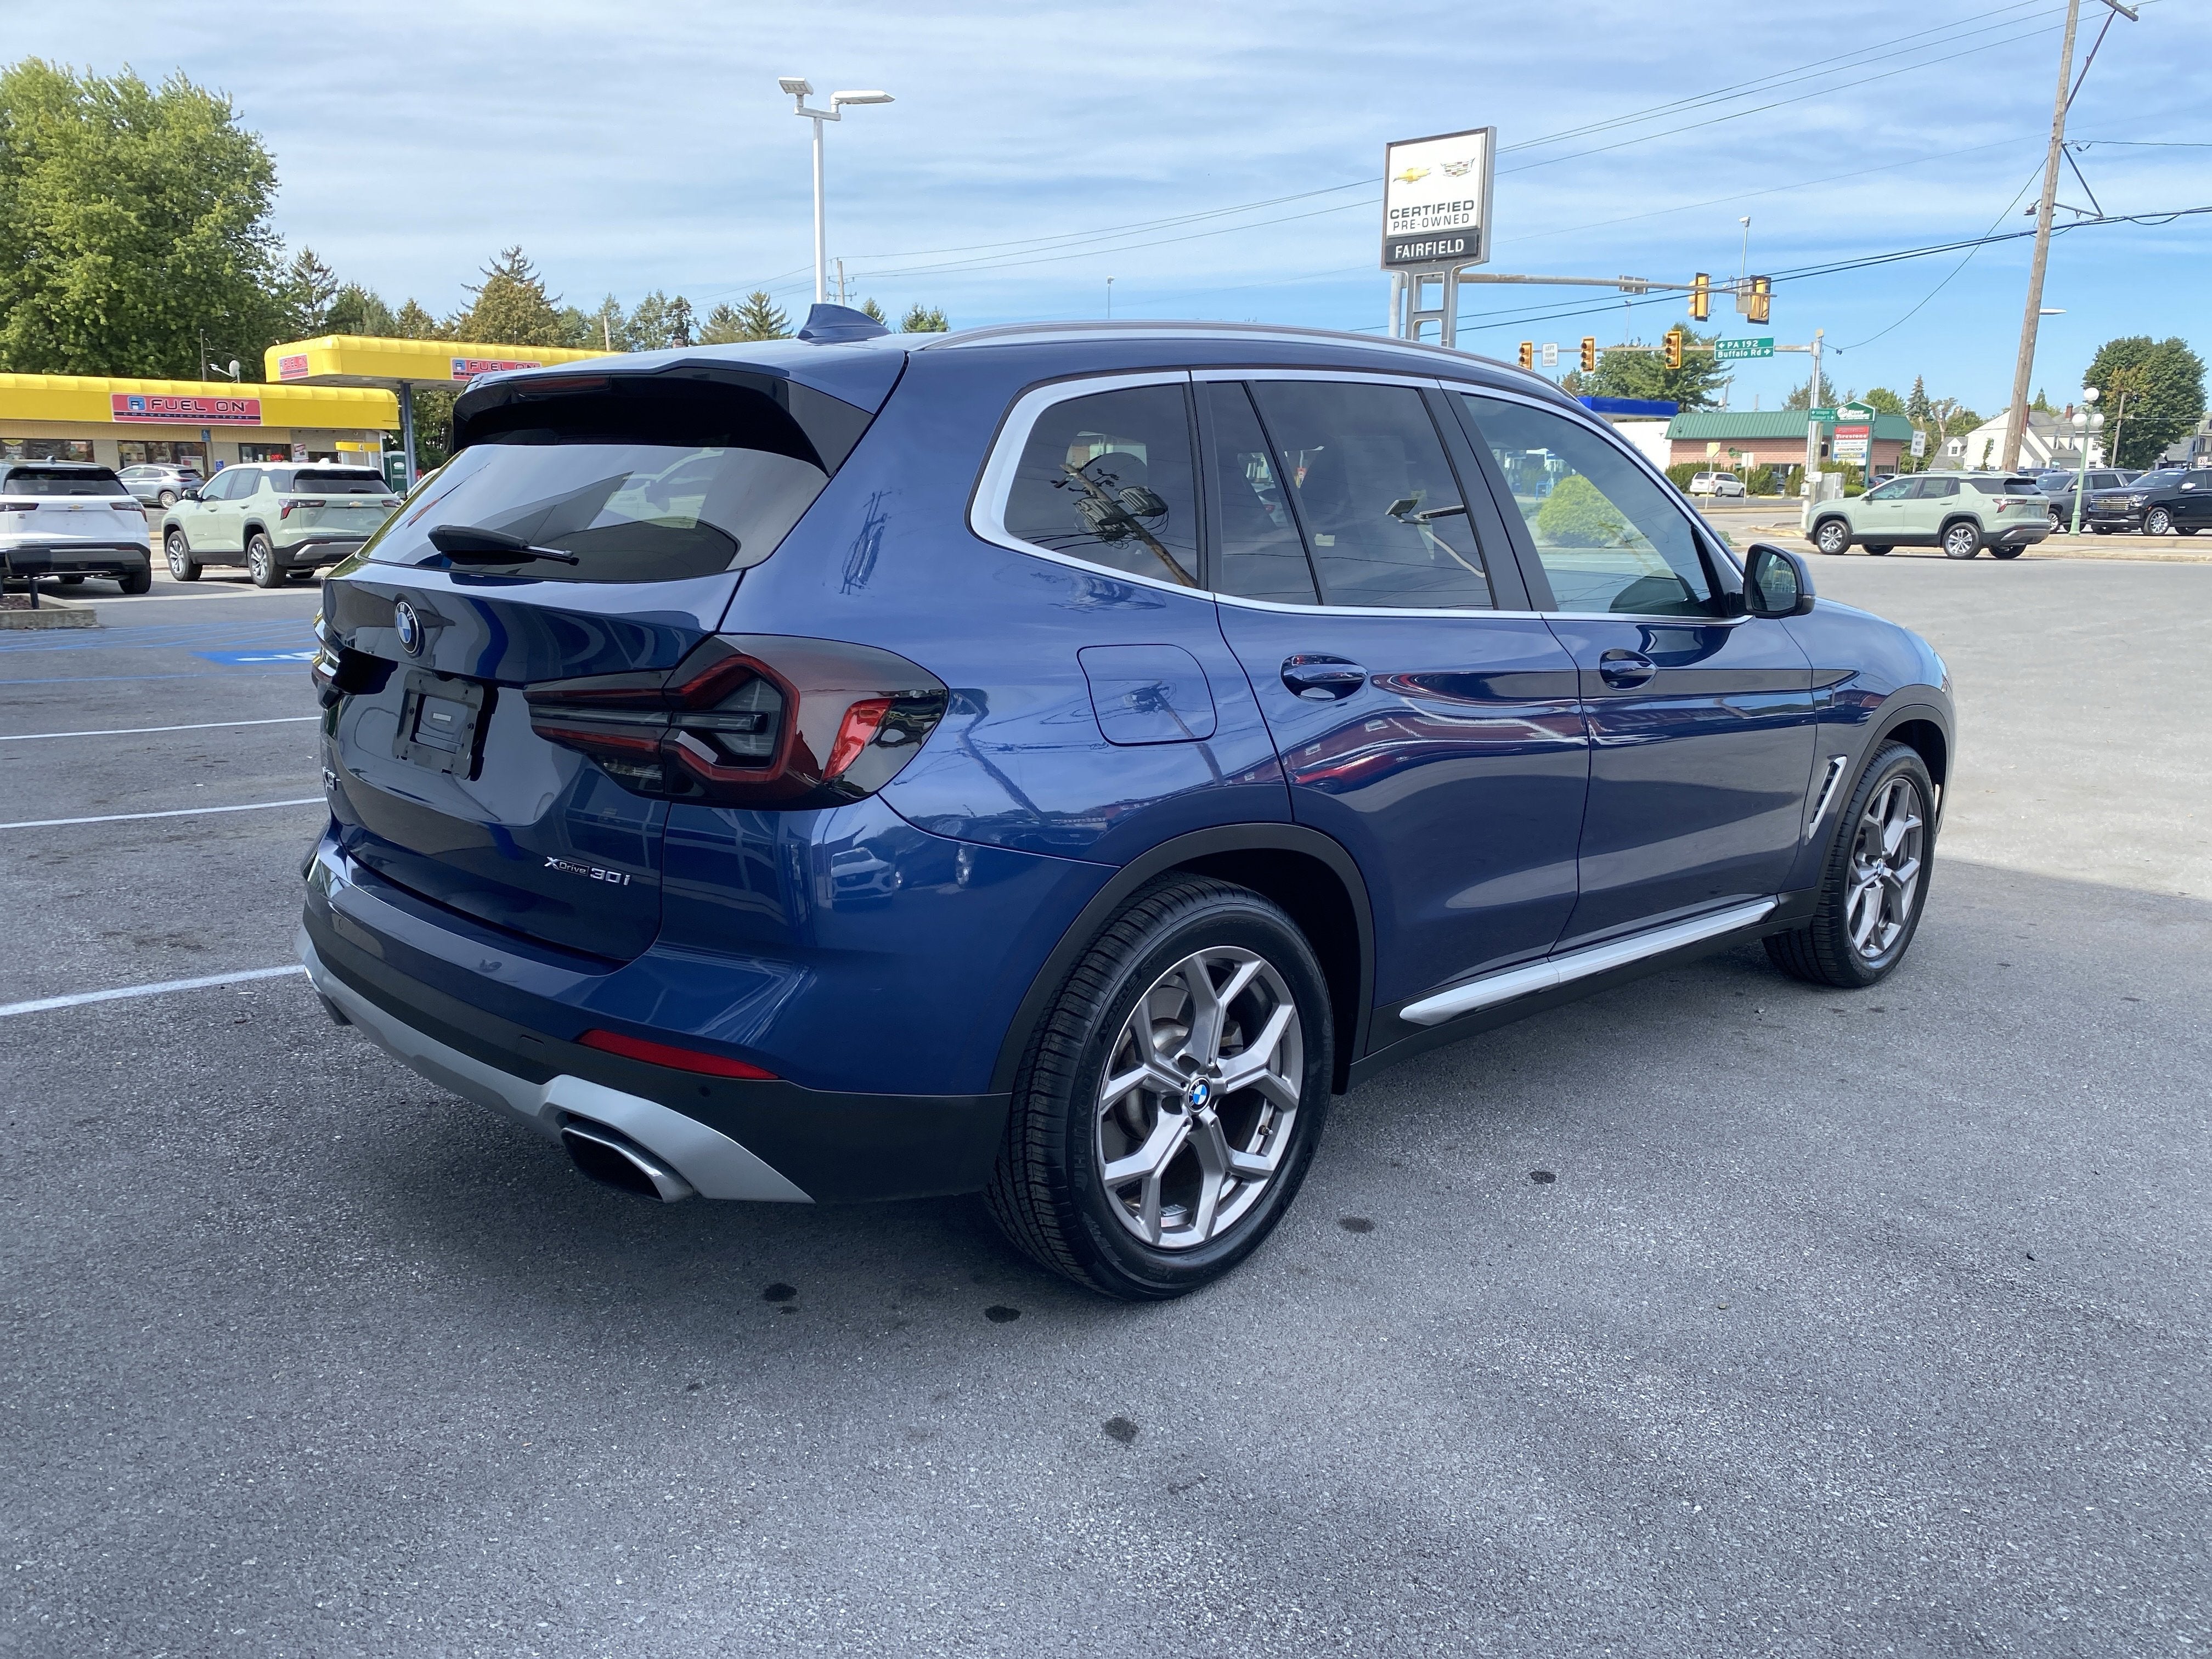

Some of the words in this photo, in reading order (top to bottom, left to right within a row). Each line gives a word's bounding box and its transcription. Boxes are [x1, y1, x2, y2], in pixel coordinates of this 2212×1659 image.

[1390, 199, 1474, 219] CERTIFIED
[1393, 213, 1469, 232] PRE-OWNED
[1395, 238, 1464, 259] FAIRFIELD
[1742, 340, 1759, 348] 192
[1718, 349, 1748, 358] Buffalo
[469, 361, 509, 371] FUEL
[150, 399, 207, 411] FUEL
[216, 400, 246, 413] ON
